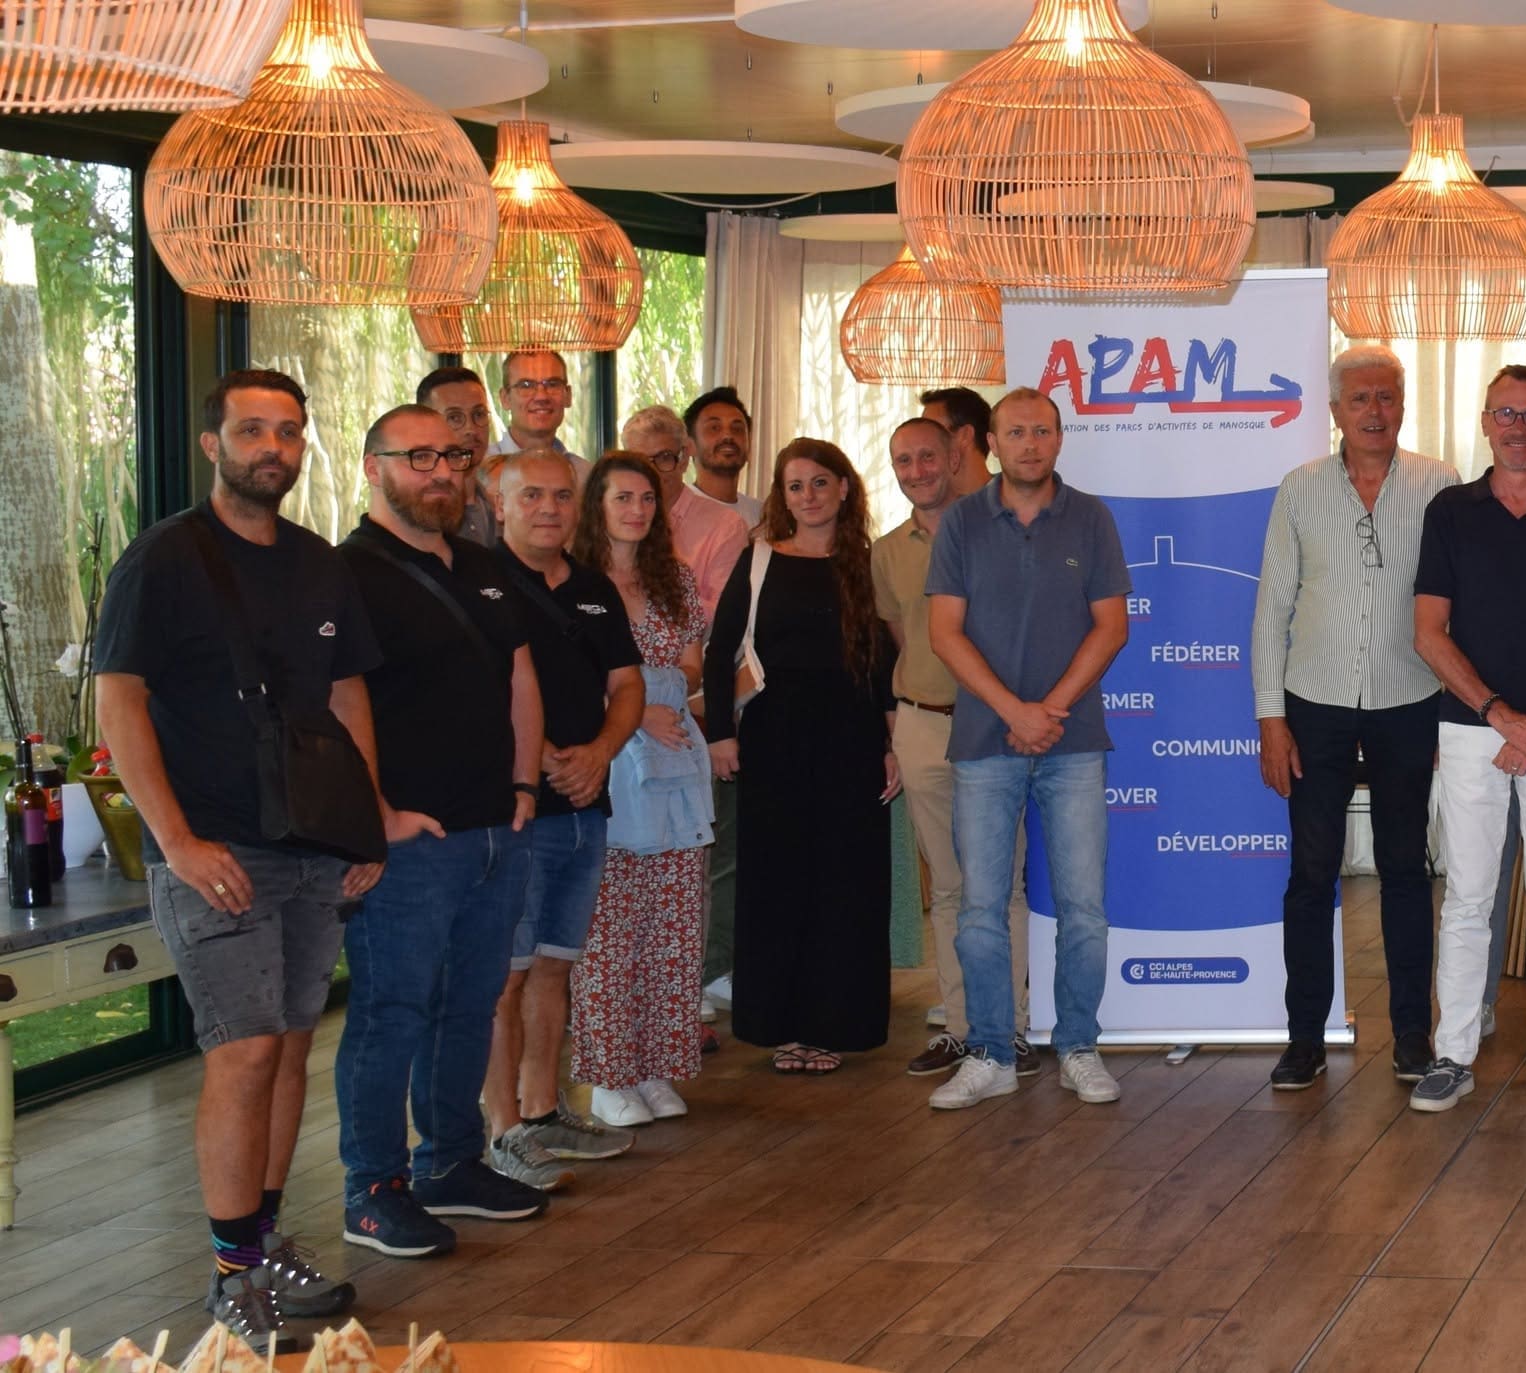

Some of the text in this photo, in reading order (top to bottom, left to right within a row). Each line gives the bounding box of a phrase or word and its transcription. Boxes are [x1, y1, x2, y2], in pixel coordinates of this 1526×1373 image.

[1038, 334, 1240, 414] APAM
[1061, 424, 1089, 433] ATION
[1094, 423, 1111, 432] DES
[1116, 423, 1143, 432] PARCS
[1202, 421, 1214, 430] DE
[1219, 420, 1266, 430] MANOSQUE
[1126, 598, 1151, 615] ER
[1151, 640, 1240, 662] FÉDÉRER
[1101, 692, 1155, 709] RMER
[1152, 739, 1261, 756] COMMUNI
[1105, 787, 1157, 804] OVER
[1157, 831, 1288, 852] DÉVELOPPER
[1149, 962, 1193, 971] CCI ALPES
[1150, 971, 1237, 979] DE-HAUTE-PROVENCE
